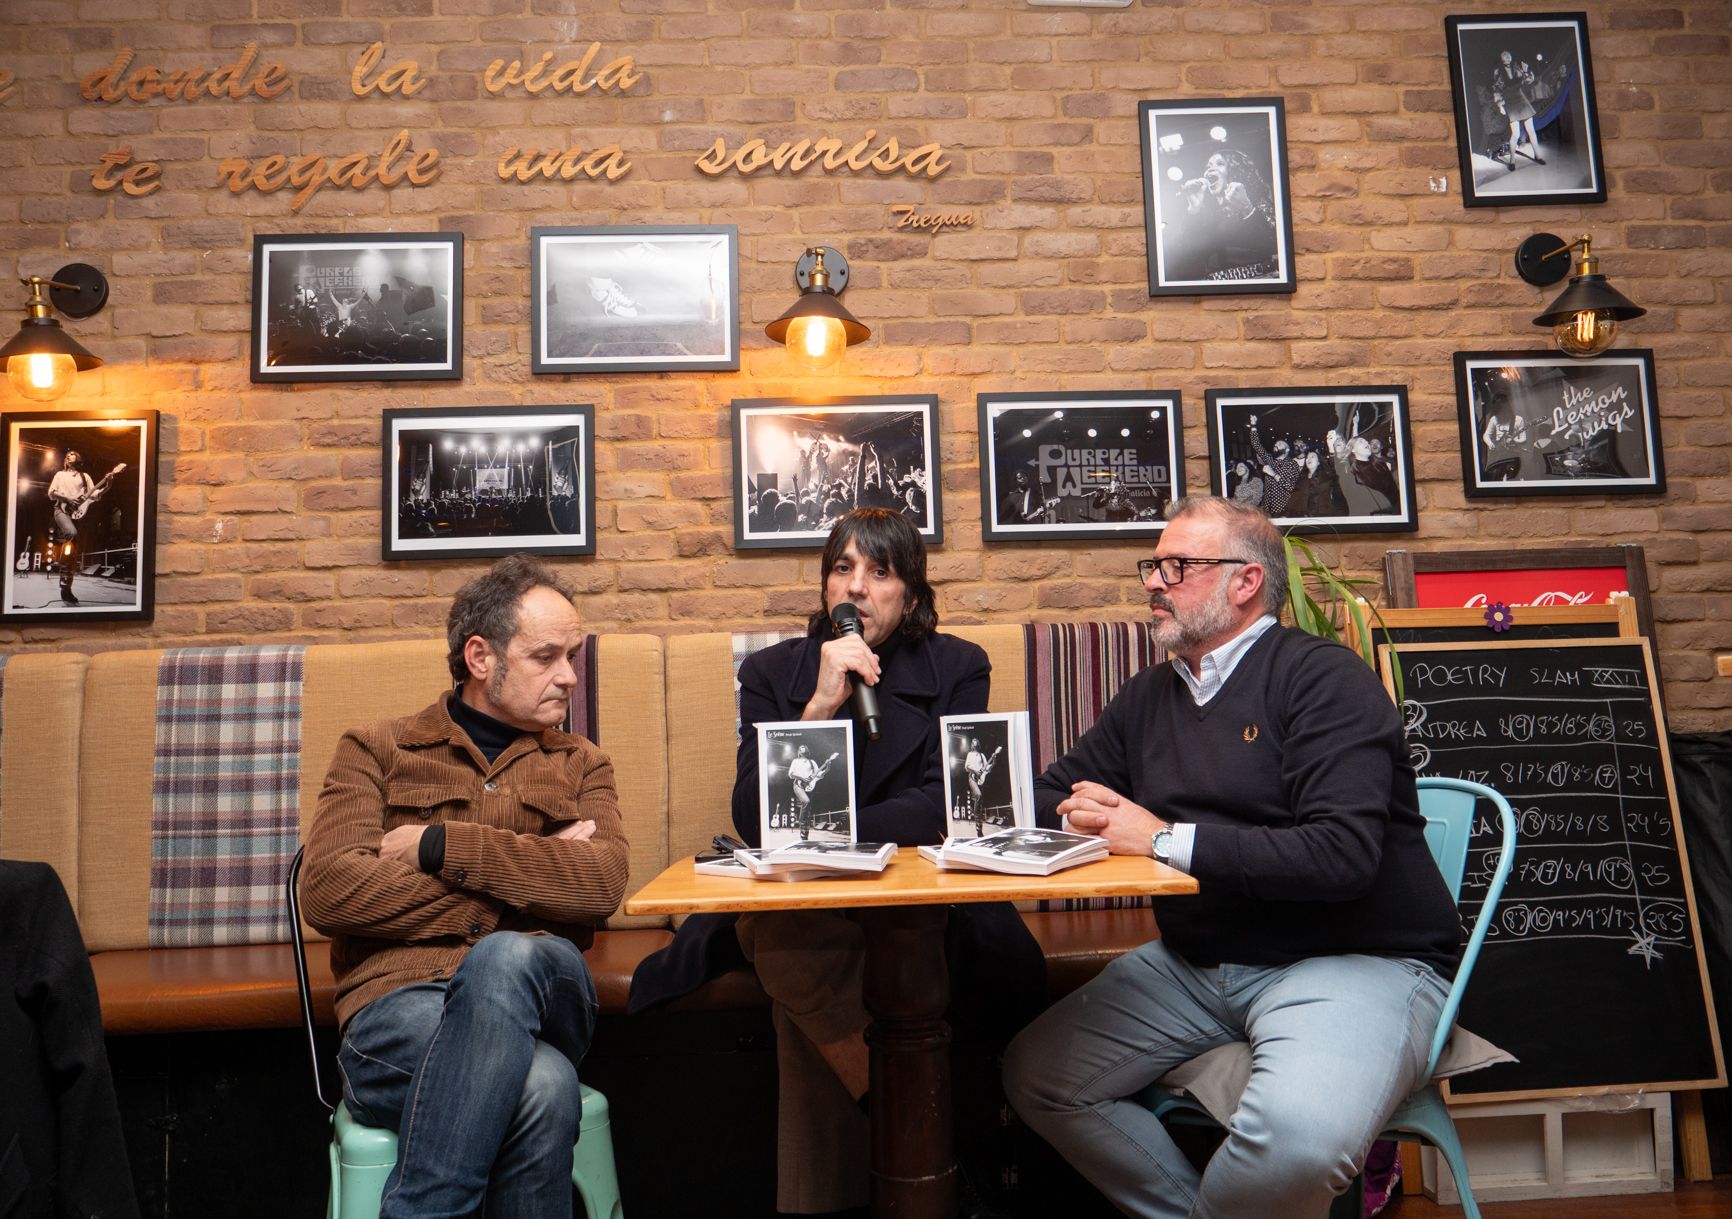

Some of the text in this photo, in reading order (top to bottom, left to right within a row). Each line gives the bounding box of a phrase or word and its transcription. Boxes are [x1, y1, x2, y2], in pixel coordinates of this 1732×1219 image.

[80, 42, 292, 101] donde
[351, 41, 428, 97] la
[484, 41, 643, 95] vida
[91, 129, 951, 212] te regale una sonrisa
[892, 205, 977, 234] Tregua
[1551, 386, 1628, 435] Lemon
[1562, 386, 1594, 408] the
[1564, 402, 1634, 447] Twigs
[1039, 445, 1138, 483] PURPLE
[1057, 466, 1167, 497] WEEKEND
[1410, 663, 1507, 688] POETRY
[1530, 668, 1580, 685] SLAM
[1404, 720, 1487, 741] ANDREA
[1623, 720, 1647, 738] 25
[1626, 764, 1654, 788] 24
[1641, 862, 1671, 886] 25
